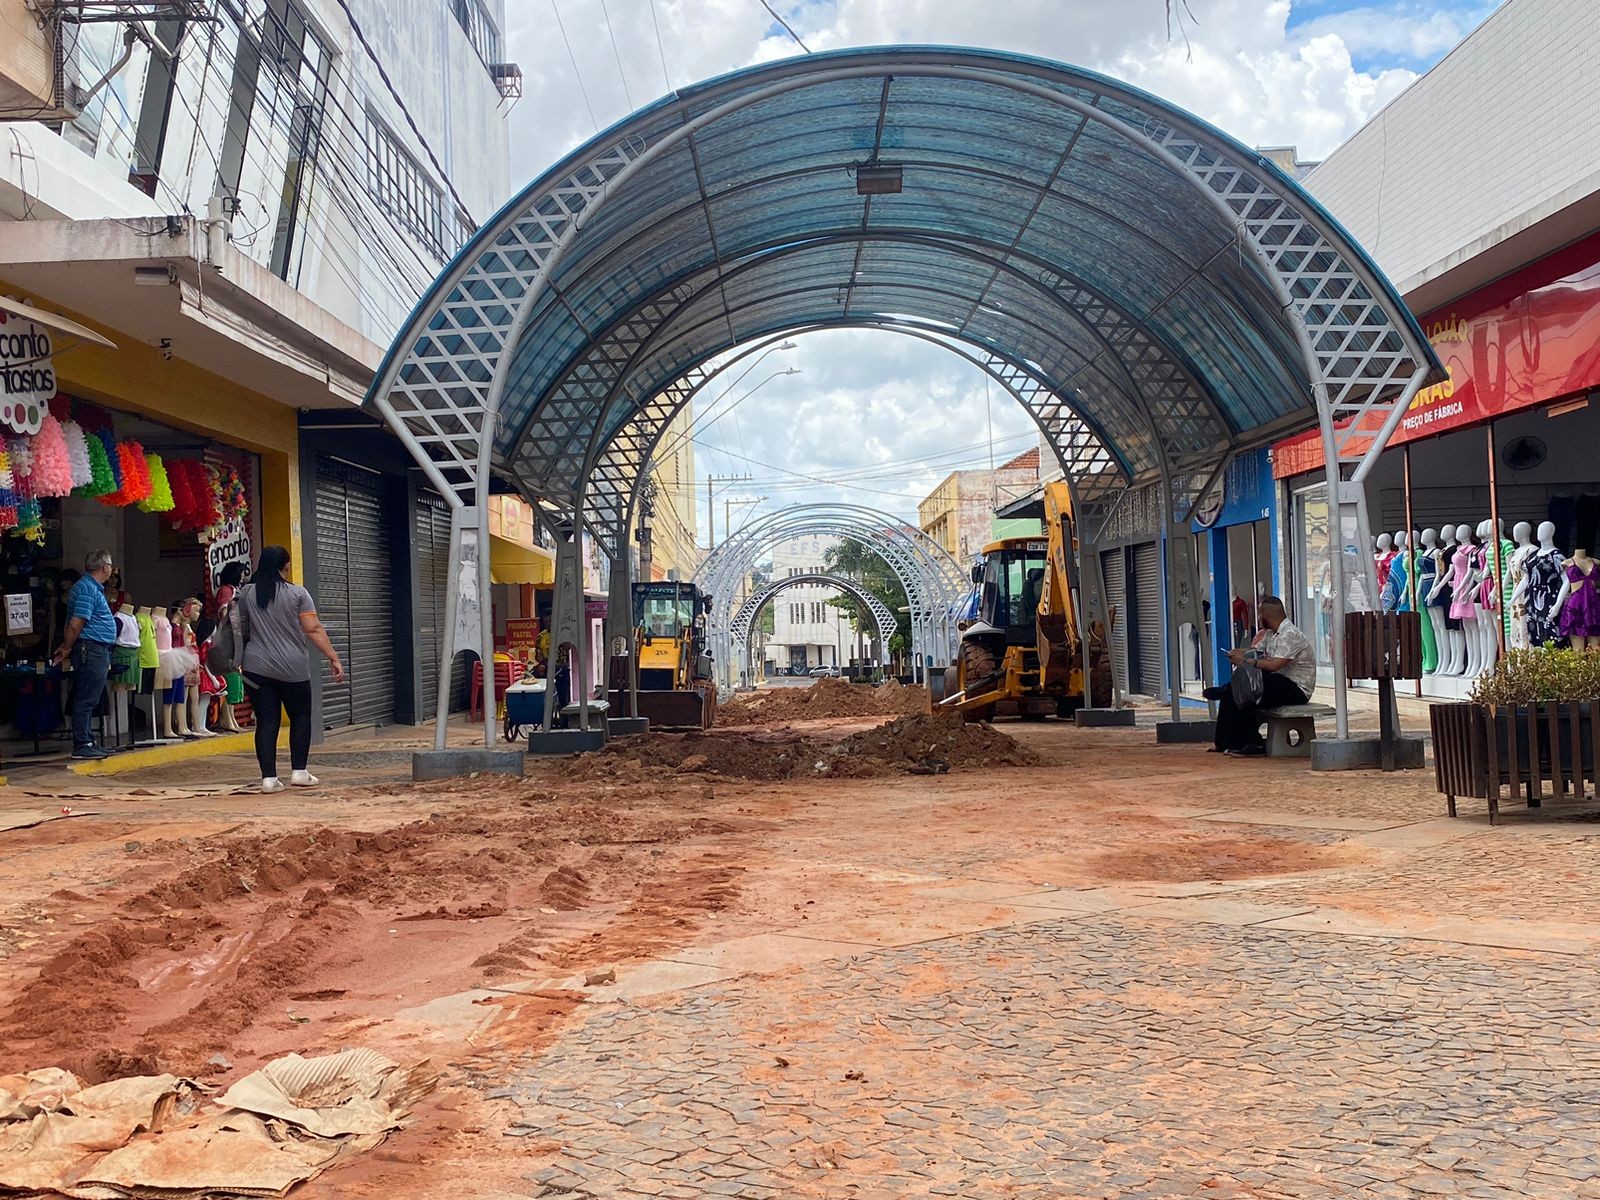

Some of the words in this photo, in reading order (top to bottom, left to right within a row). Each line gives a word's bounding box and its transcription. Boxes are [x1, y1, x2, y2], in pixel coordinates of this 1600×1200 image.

[1403, 414, 1424, 430] PREÇO
[1424, 411, 1434, 424] DE
[1434, 401, 1464, 421] FÁBRICA
[210, 533, 249, 566] encanto
[508, 621, 537, 630] PROMOÇÃO
[513, 631, 532, 639] PASTEL
